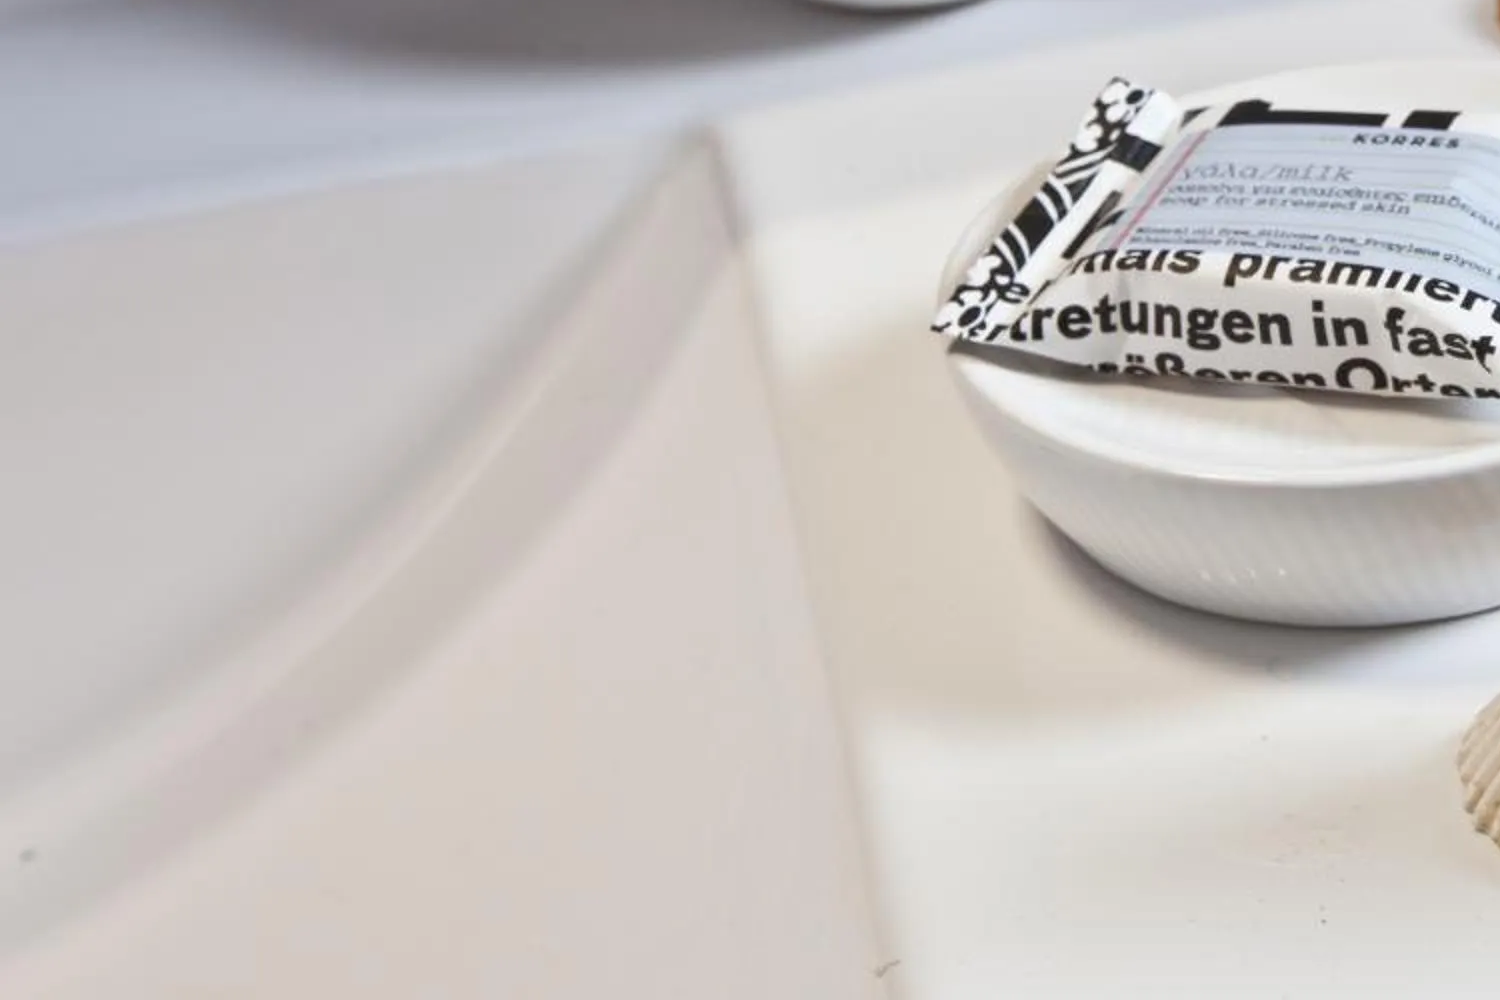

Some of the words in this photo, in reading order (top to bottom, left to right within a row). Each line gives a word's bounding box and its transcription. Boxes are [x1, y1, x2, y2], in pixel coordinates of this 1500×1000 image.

[1353, 132, 1460, 149] KORRES
[1360, 201, 1411, 216] skin
[1311, 299, 1370, 348] in
[1384, 305, 1497, 374] fast
